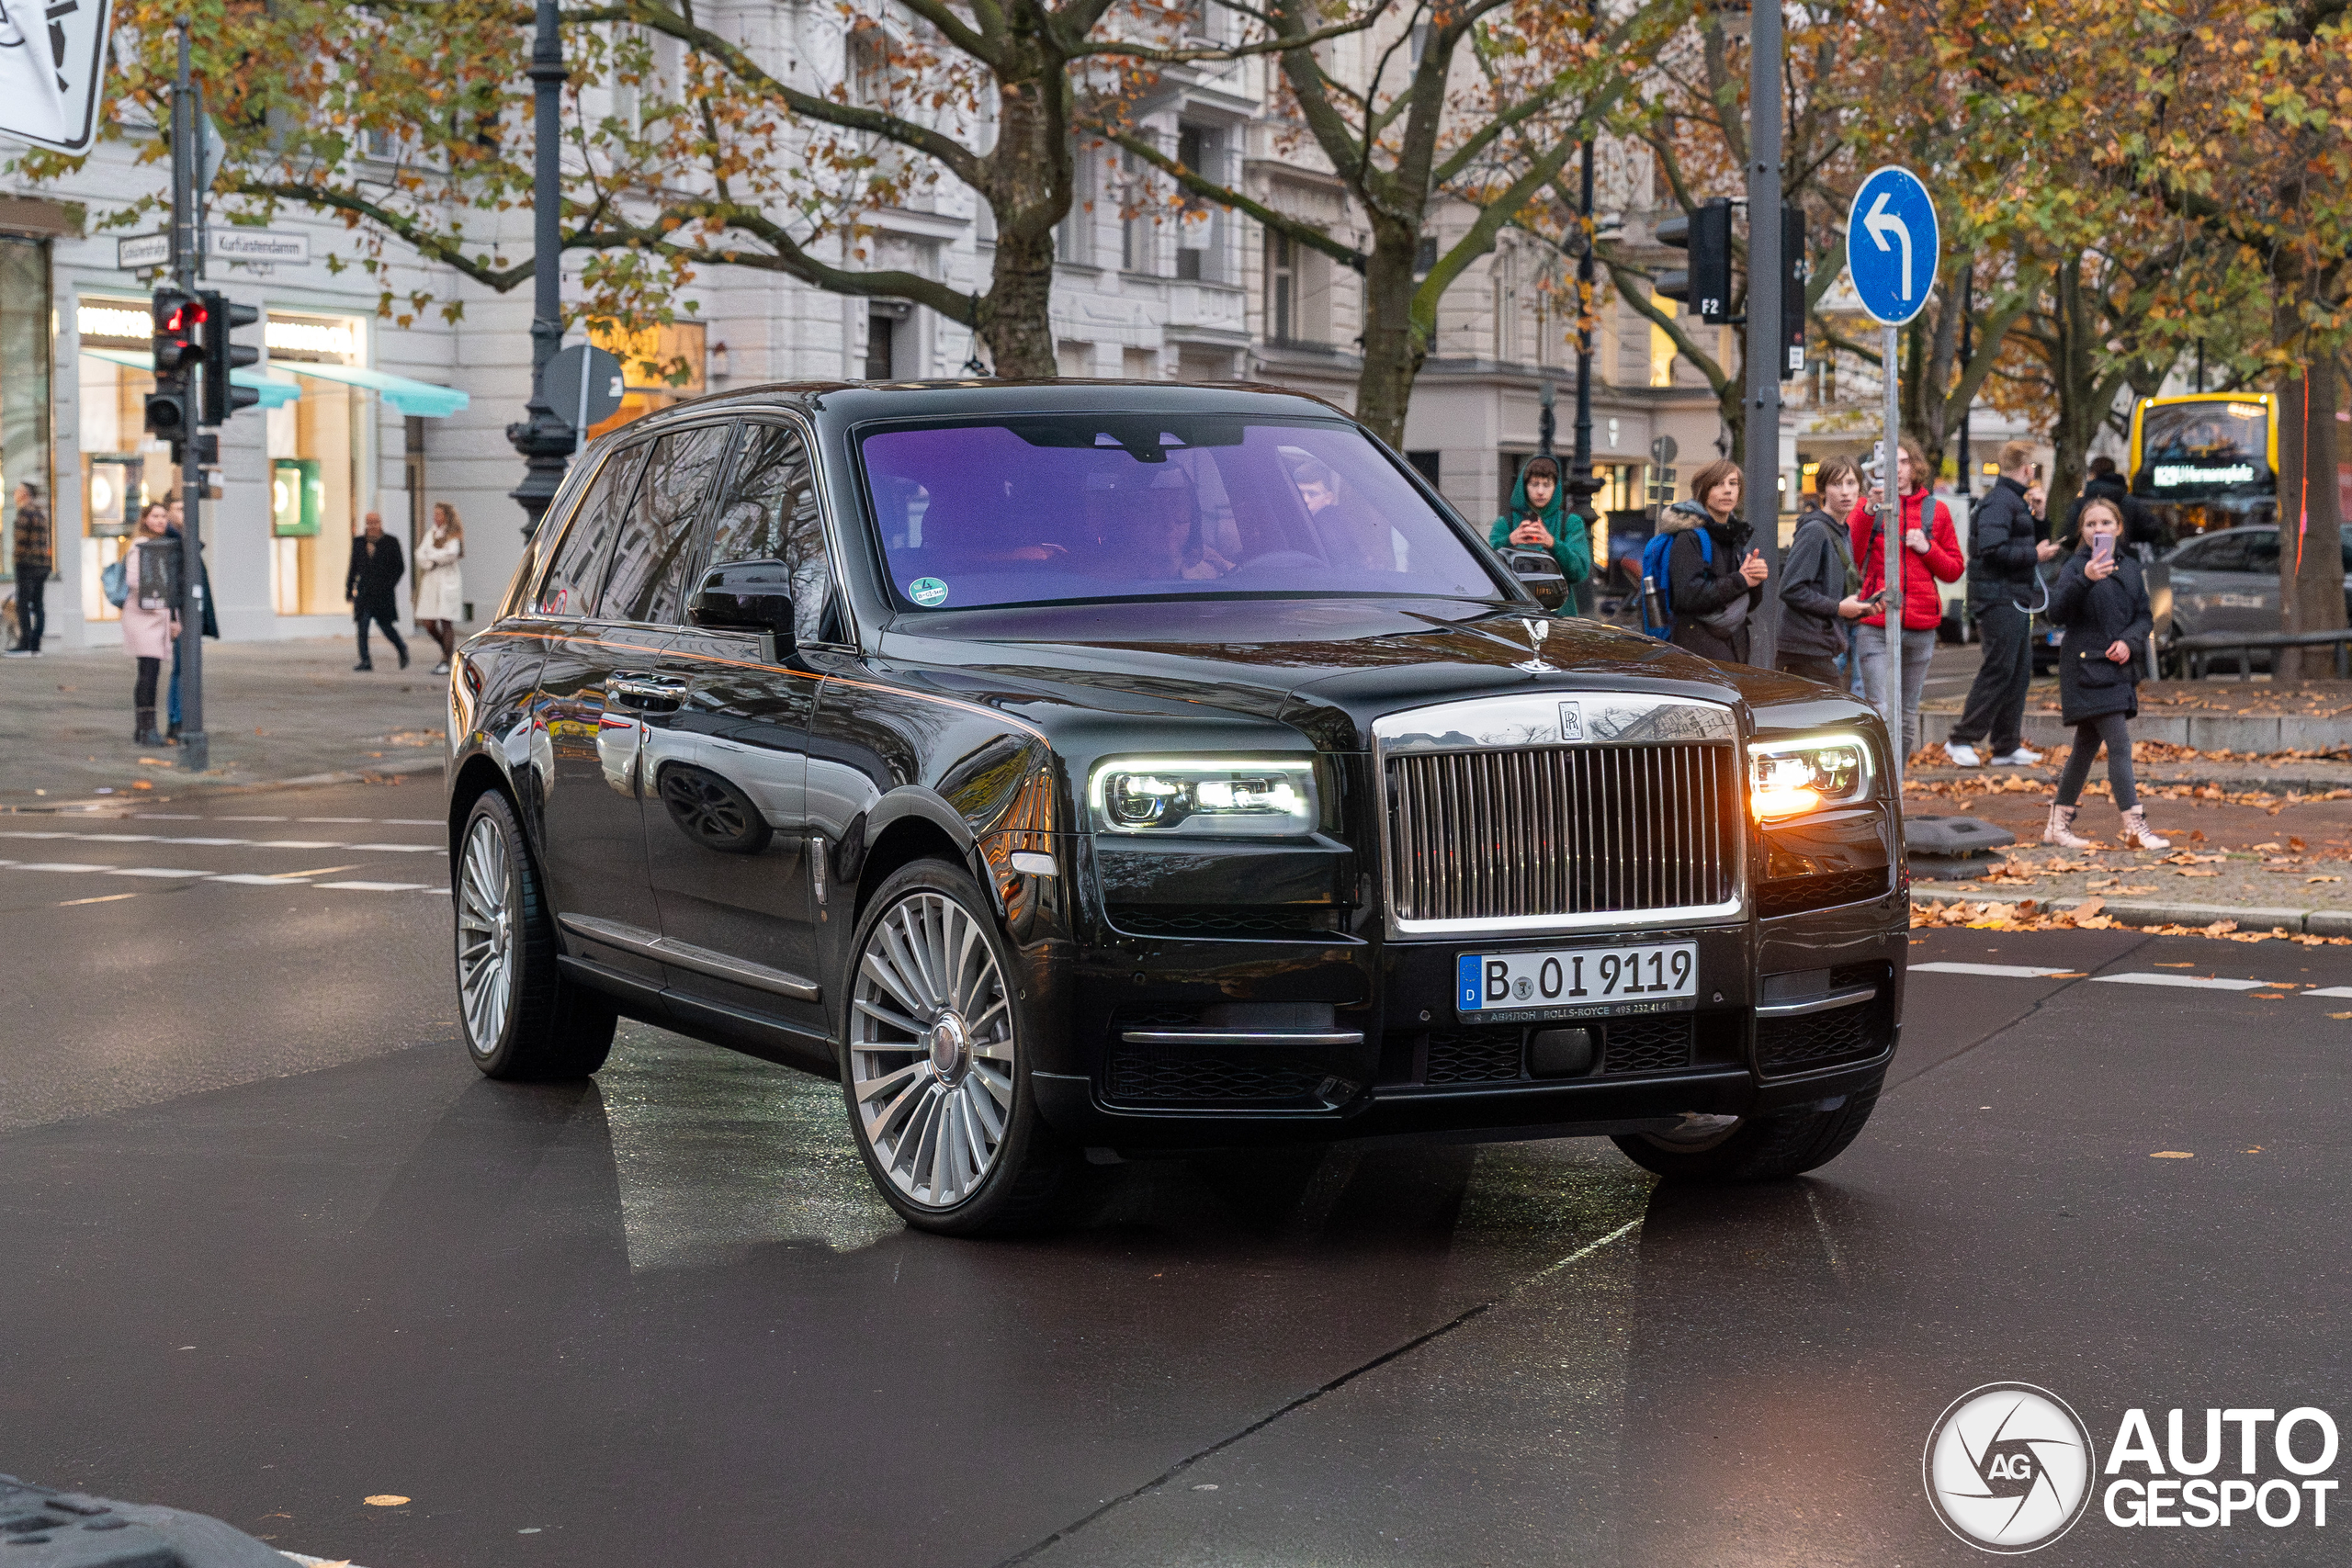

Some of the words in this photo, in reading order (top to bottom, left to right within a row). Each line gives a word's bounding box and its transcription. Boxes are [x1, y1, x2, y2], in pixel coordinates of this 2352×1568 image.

[1702, 299, 1718, 314] F2
[922, 580, 933, 590] 4
[1486, 960, 1510, 1001] B
[1540, 956, 1588, 998] OI
[1600, 950, 1691, 995] 9119
[1466, 989, 1475, 1000] D
[1544, 1007, 1610, 1019] ROLLS-ROYCE
[1633, 1004, 1648, 1013] 232
